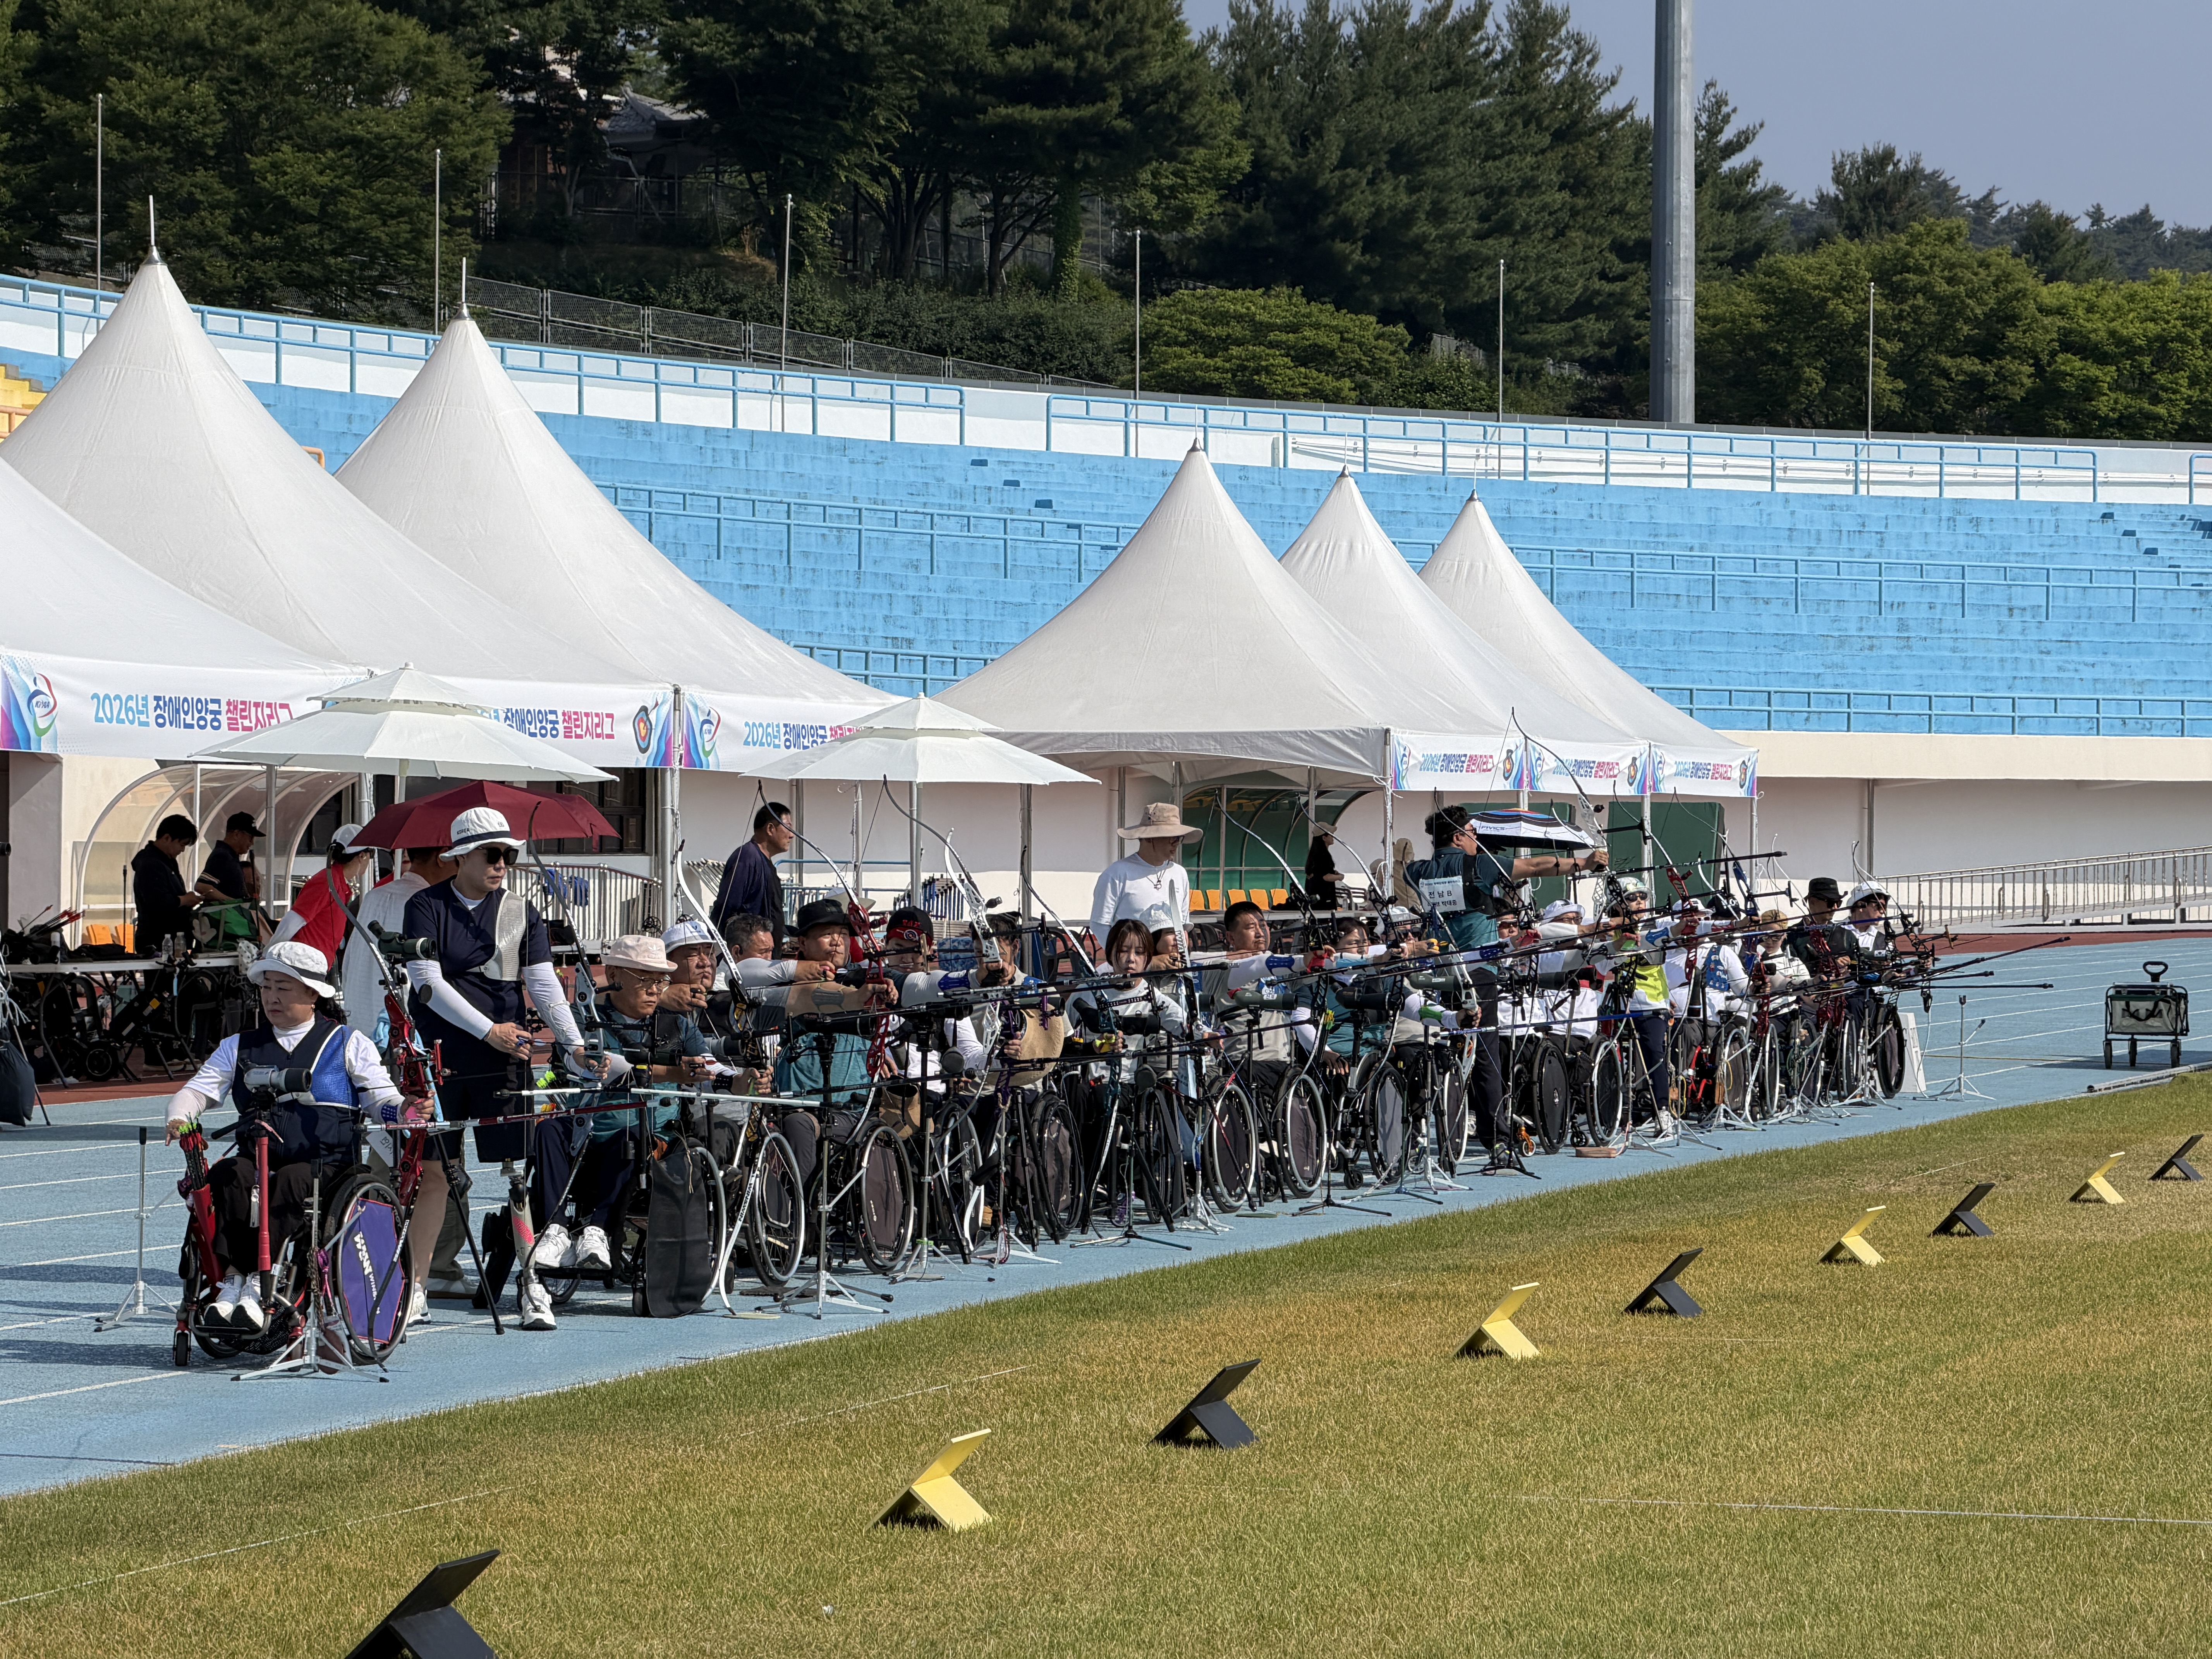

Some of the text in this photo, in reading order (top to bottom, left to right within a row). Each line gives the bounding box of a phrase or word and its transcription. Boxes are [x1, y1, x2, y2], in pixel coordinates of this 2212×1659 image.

[91, 692, 150, 727] 2026년
[153, 695, 222, 731] 장애인양궁
[562, 710, 615, 740] 챌린지리그
[743, 721, 781, 749] 2026년
[783, 723, 828, 750] 장애인양궁
[1419, 753, 1441, 773] 2026년
[1440, 753, 1467, 773] 장애인양궁
